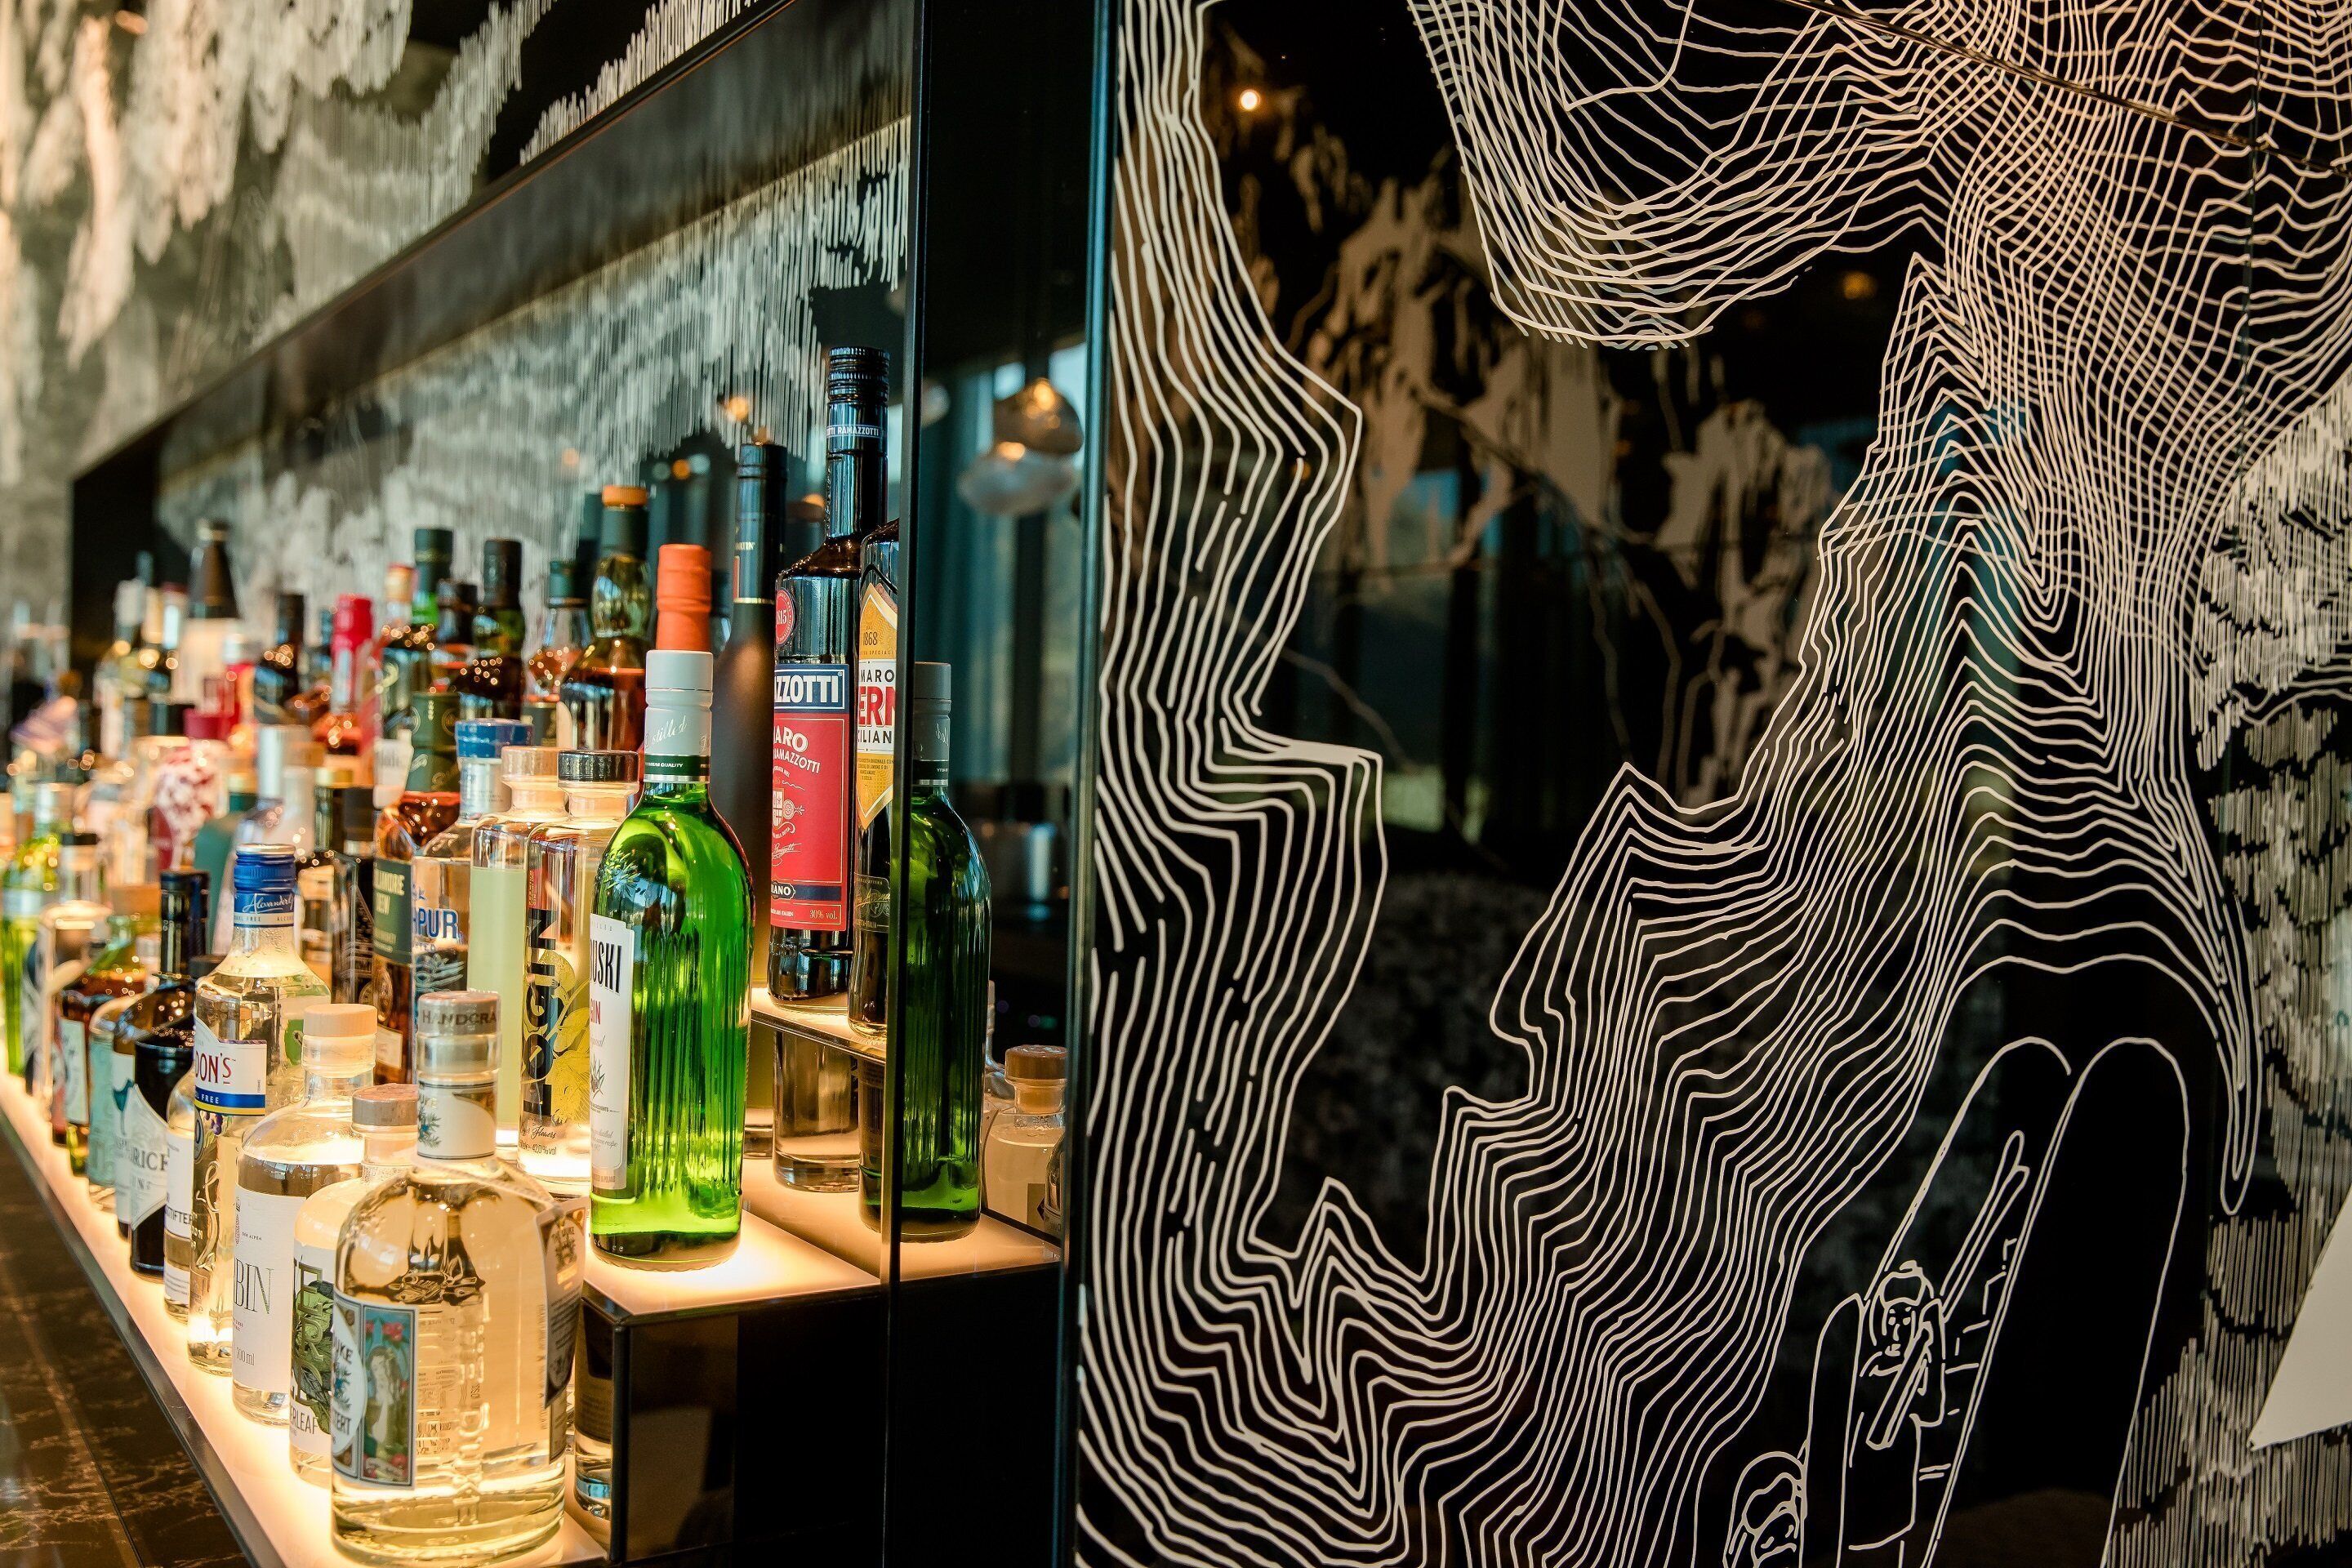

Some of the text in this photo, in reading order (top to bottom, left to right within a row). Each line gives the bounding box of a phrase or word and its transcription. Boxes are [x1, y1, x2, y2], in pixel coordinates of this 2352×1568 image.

[837, 427, 879, 436] RAMAZZOTTI
[863, 631, 878, 646] 1868
[774, 675, 839, 703] ZZOTTI
[774, 726, 808, 753] ARO
[809, 909, 838, 920] 30% vol.
[590, 998, 601, 1025] GIN
[202, 1094, 219, 1105] FREE
